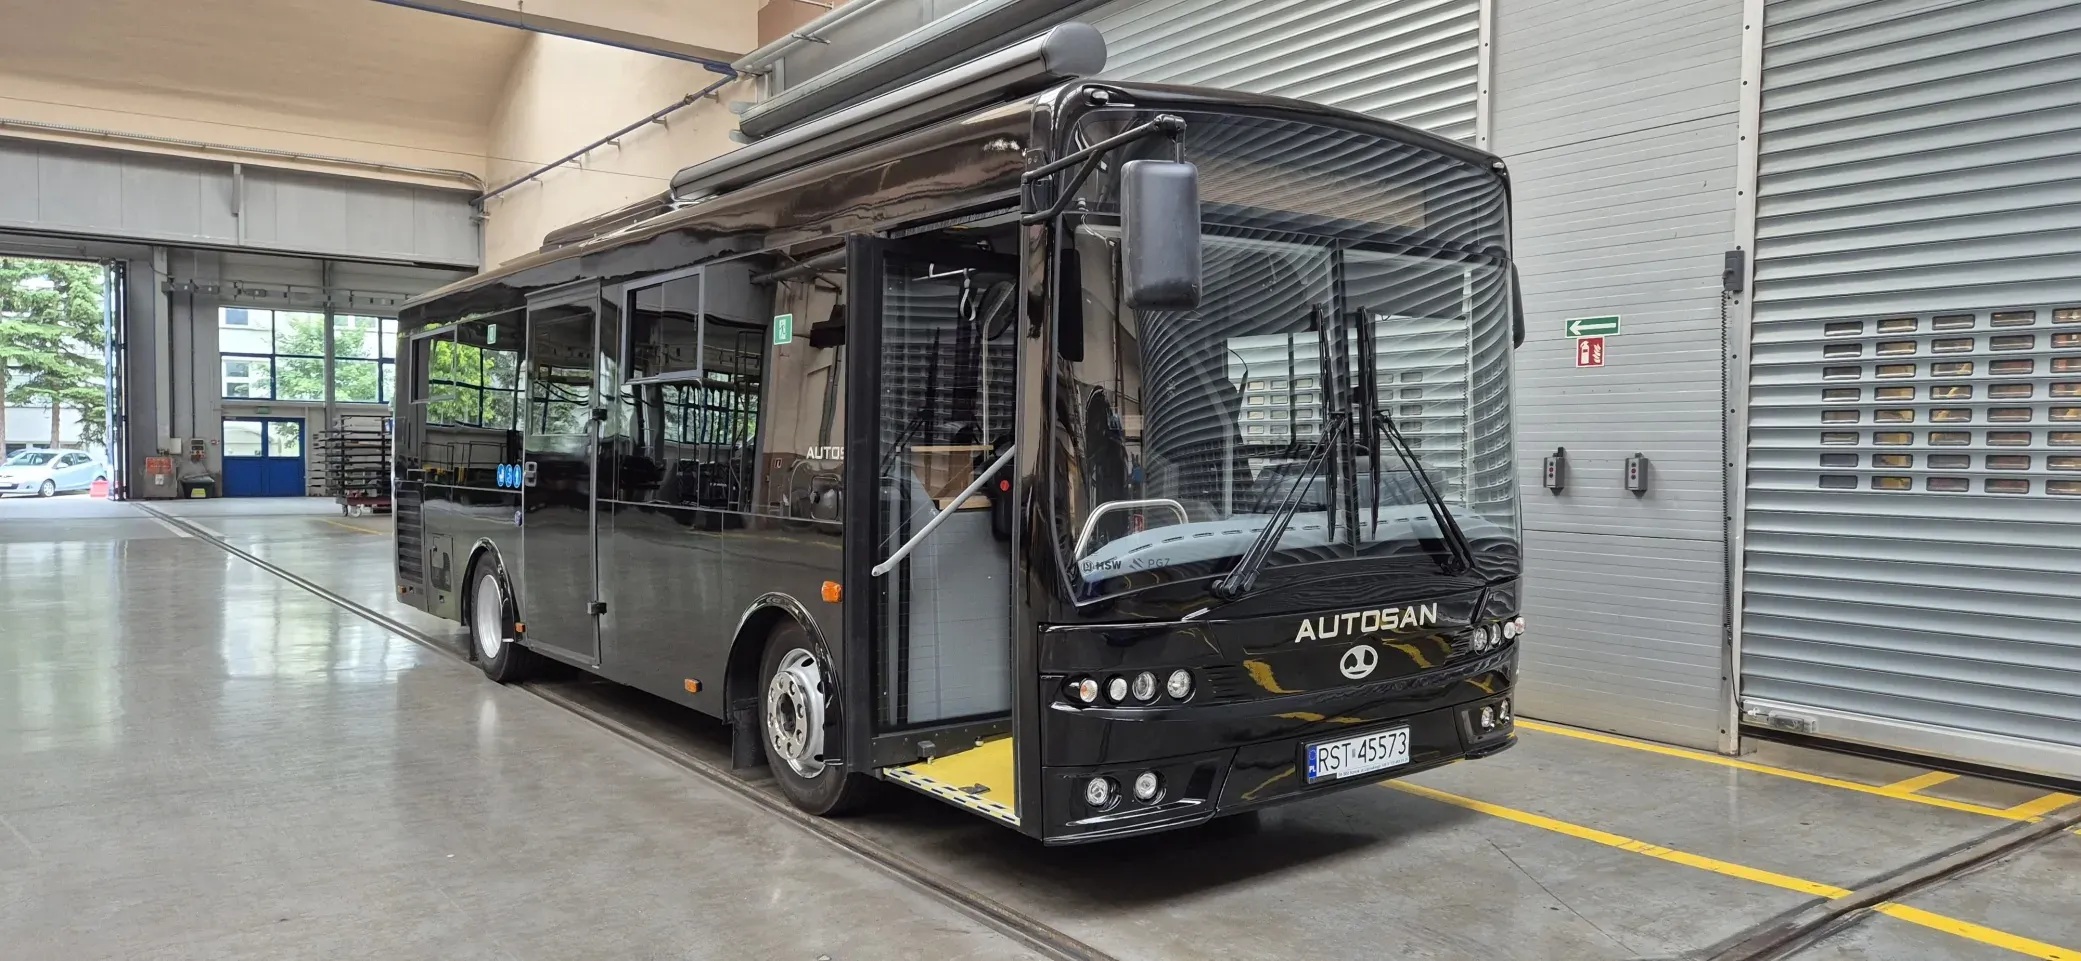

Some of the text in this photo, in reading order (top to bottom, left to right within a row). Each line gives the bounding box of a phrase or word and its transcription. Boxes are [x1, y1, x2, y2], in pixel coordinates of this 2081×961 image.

[1095, 560, 1122, 570] HSW
[1294, 602, 1438, 643] AUTOSAN
[1318, 742, 1351, 773] RST
[1357, 731, 1407, 764] 45573
[1308, 765, 1317, 774] PL
